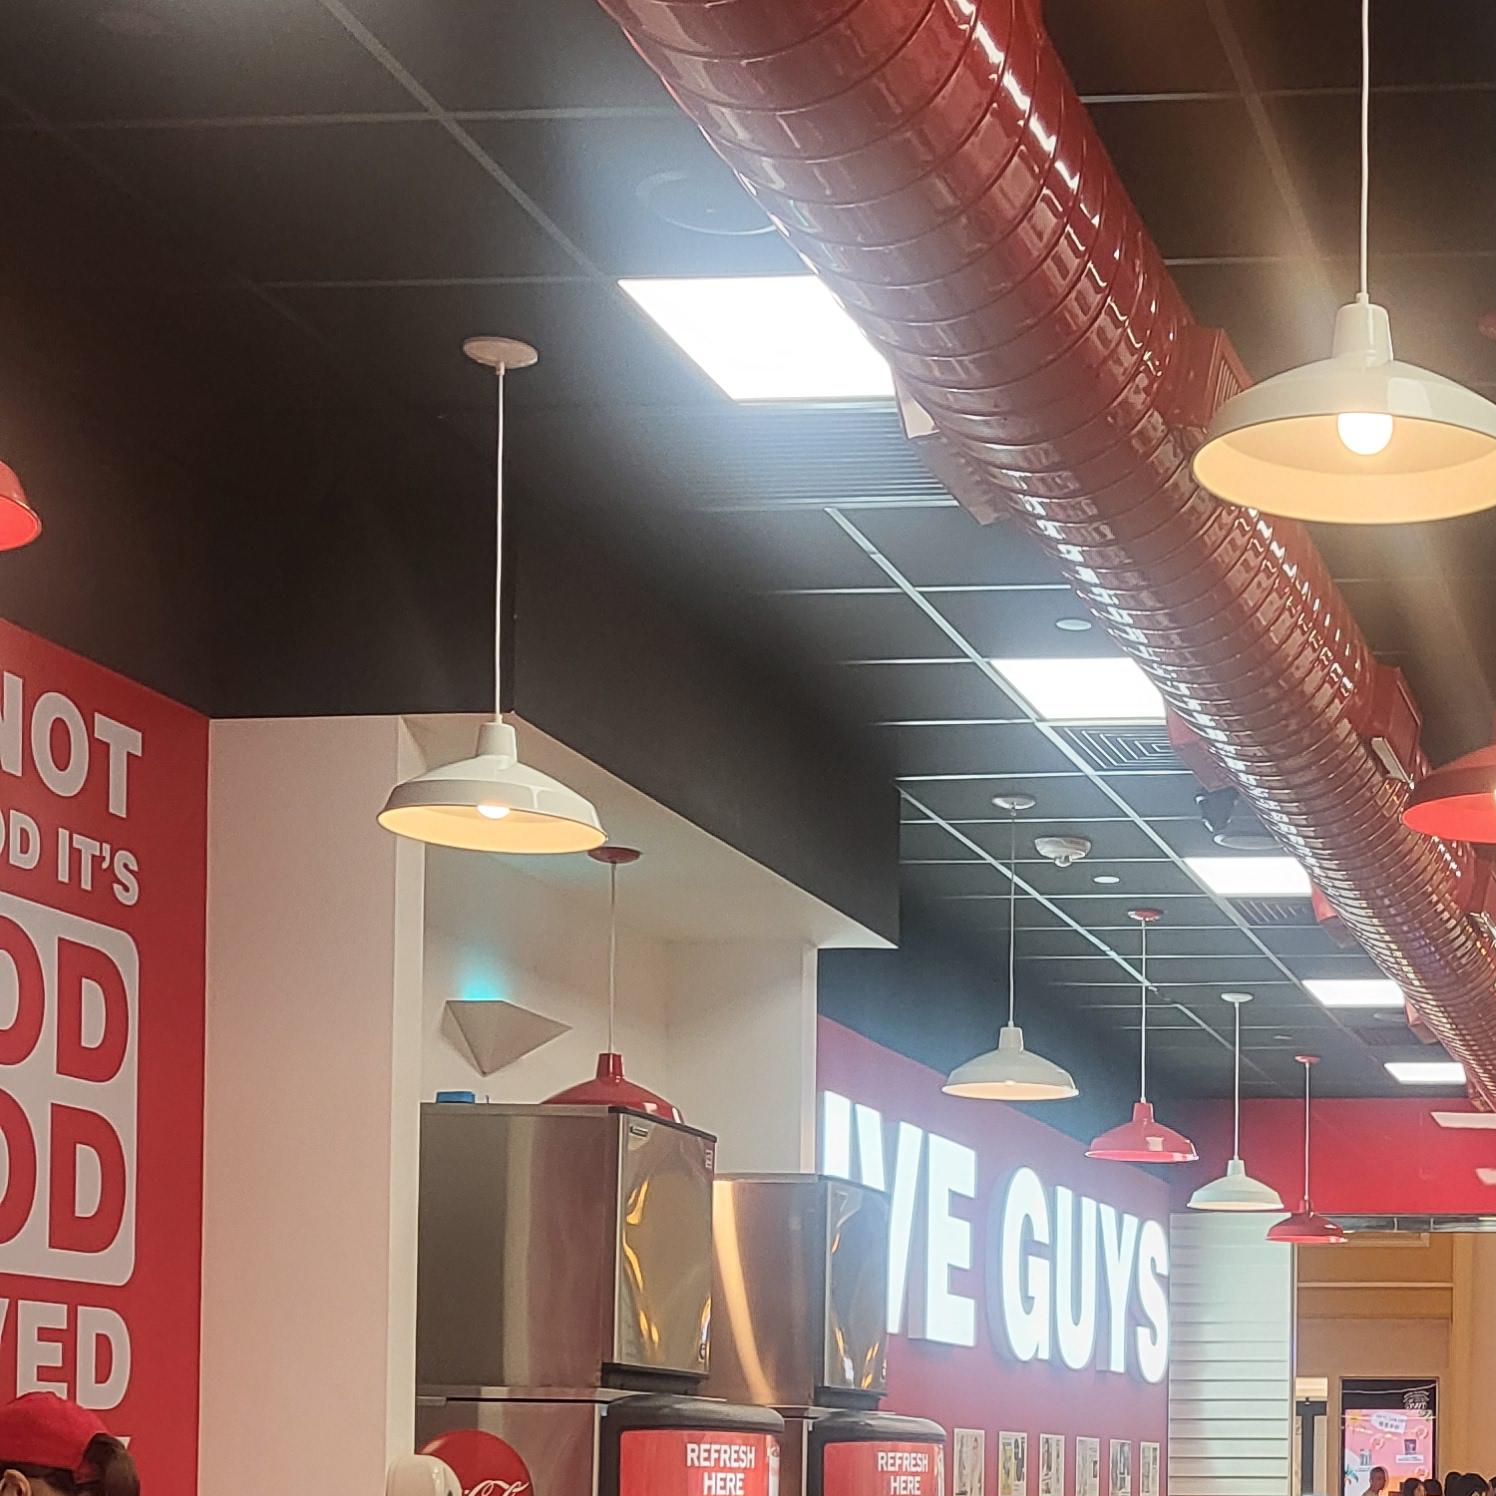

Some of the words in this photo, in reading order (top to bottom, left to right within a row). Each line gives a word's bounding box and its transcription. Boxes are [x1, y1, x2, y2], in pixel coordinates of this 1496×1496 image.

[0, 670, 142, 818] NOT
[0, 808, 41, 870] D
[1002, 1166, 1169, 1384] GUYS
[0, 1298, 131, 1410] ED
[686, 1443, 756, 1469] REFRESH
[878, 1452, 928, 1472] REFRESH
[703, 1472, 745, 1496] HERE
[890, 1476, 921, 1496] HERE
